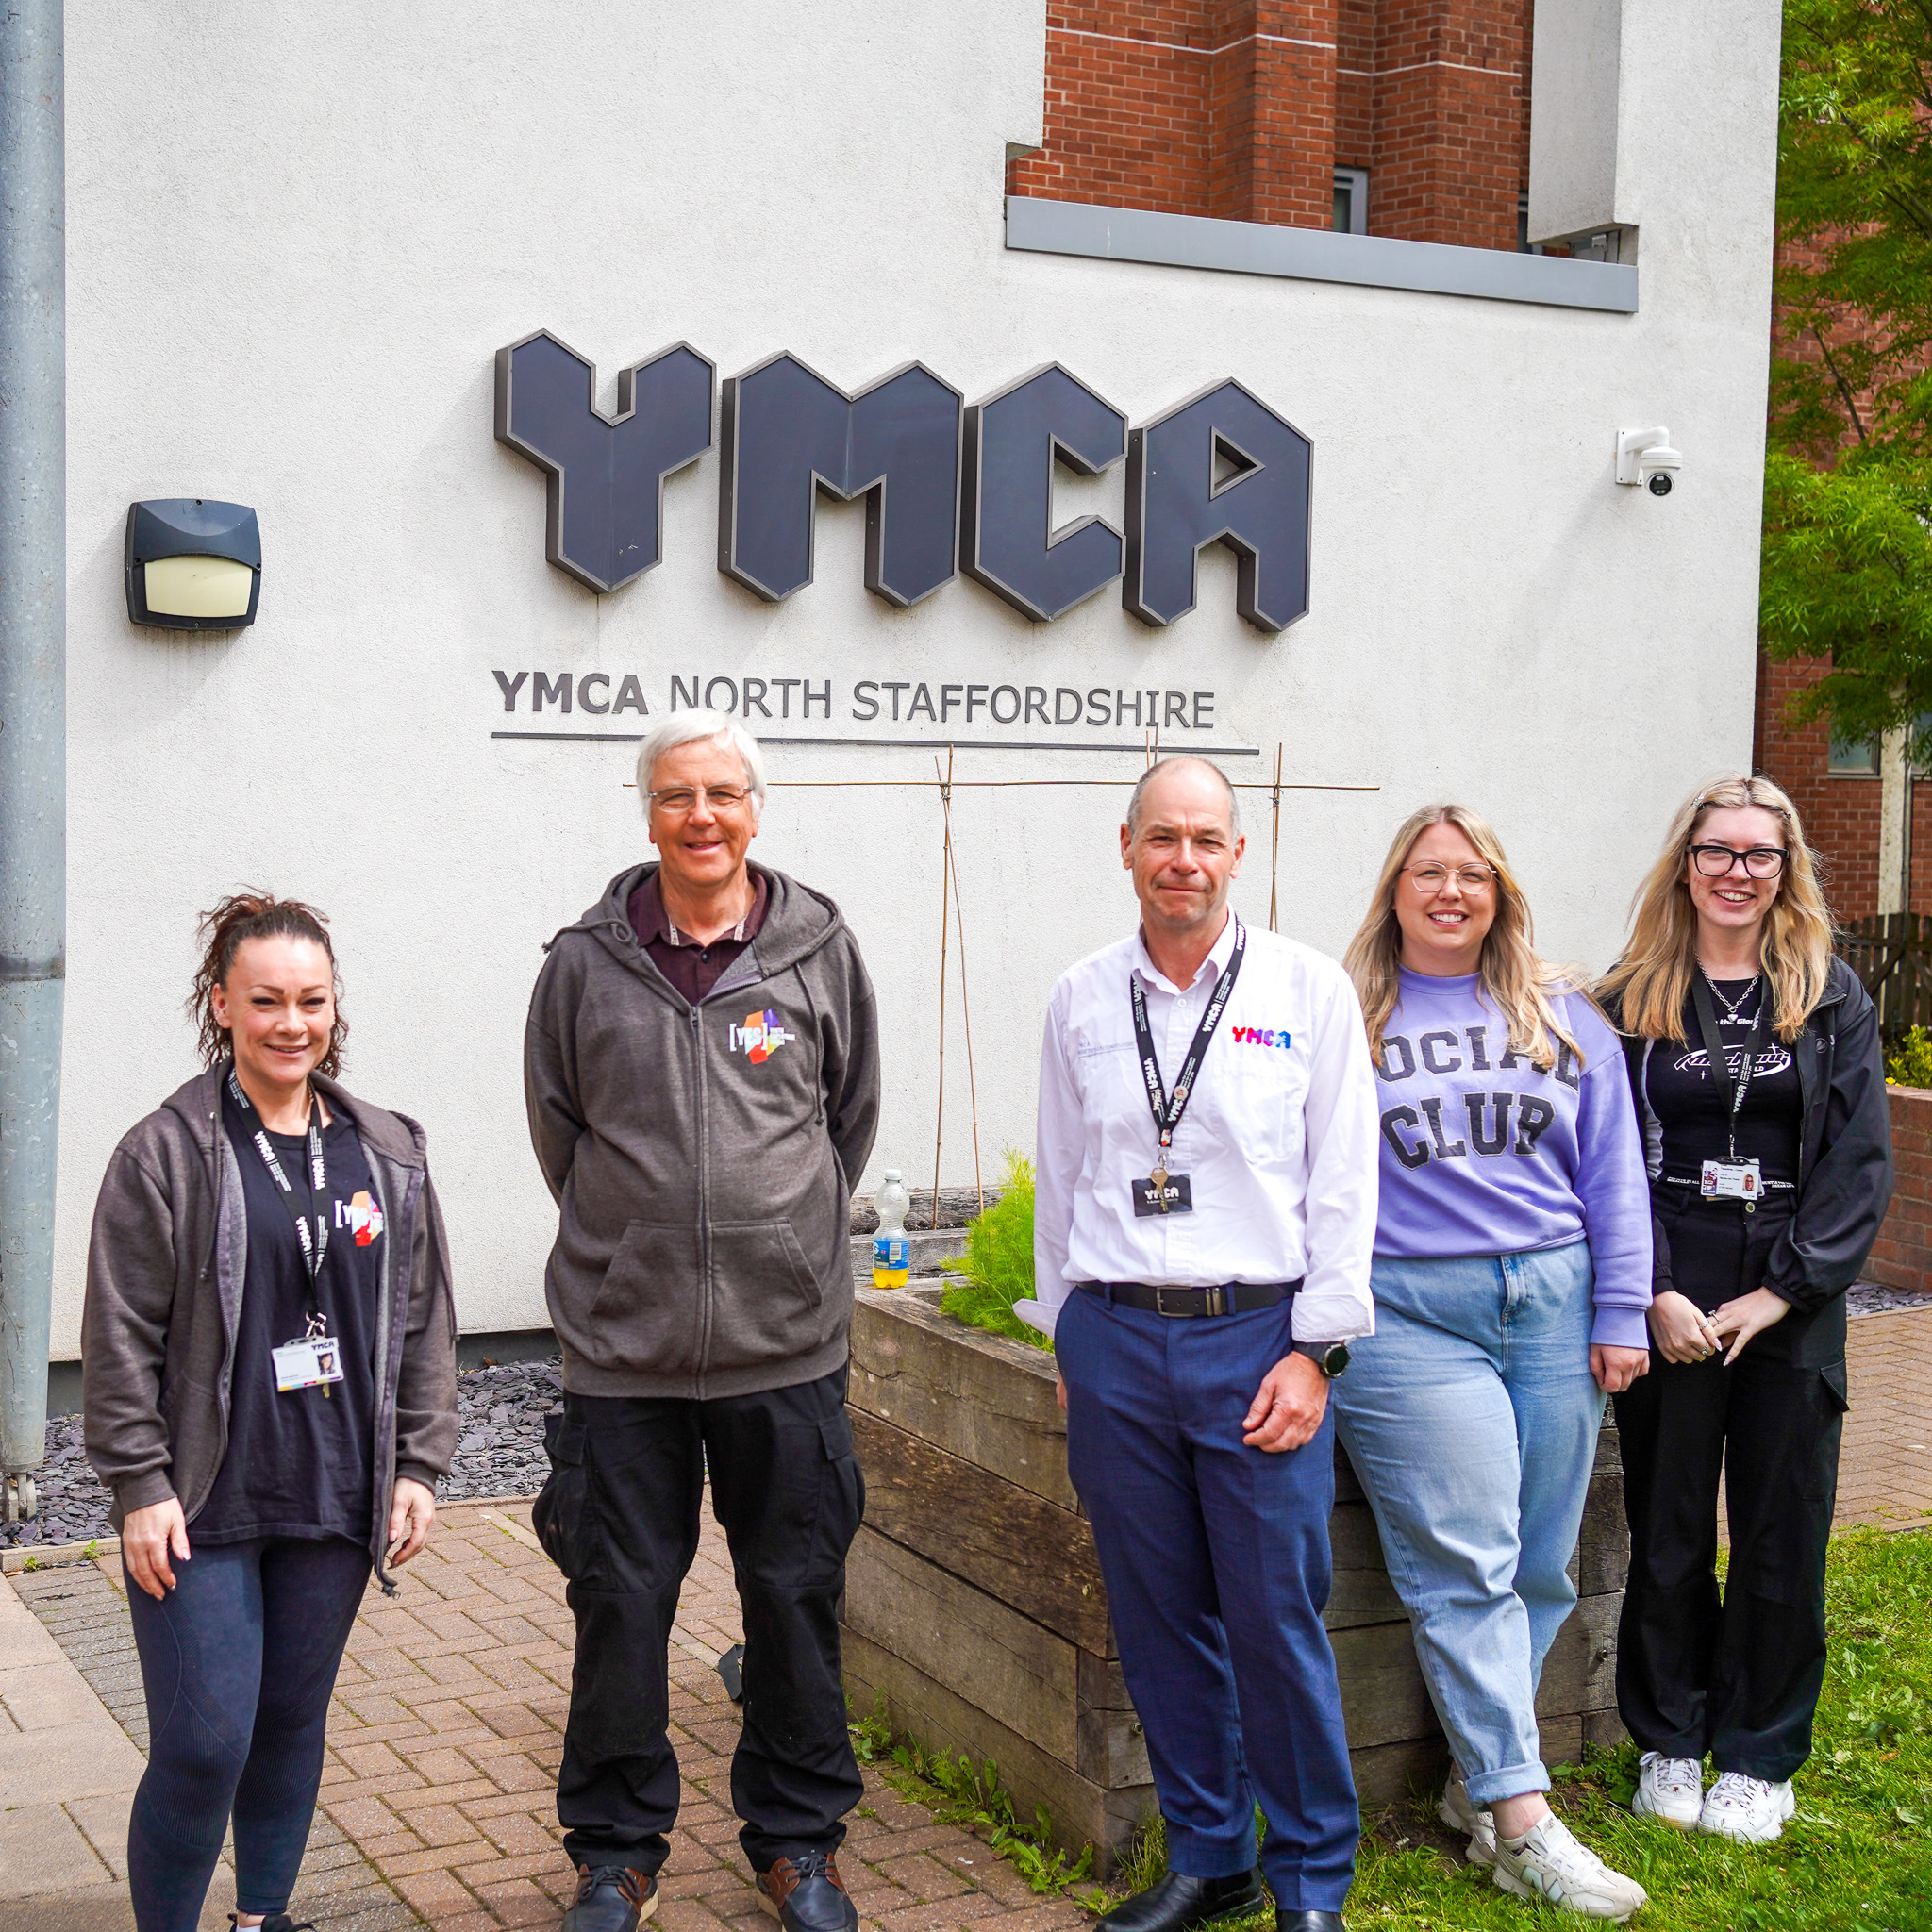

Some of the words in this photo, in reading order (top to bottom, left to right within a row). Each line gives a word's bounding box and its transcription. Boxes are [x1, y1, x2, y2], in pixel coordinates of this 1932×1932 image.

[494, 327, 1314, 633] YMCA
[491, 670, 648, 715] YMCA
[668, 675, 832, 719] NORTH
[852, 680, 1216, 729] STAFFORDSHIRE
[1202, 1003, 1223, 1032] YMCA
[1232, 1026, 1291, 1049] YMCA
[1143, 1057, 1158, 1090] YMCA
[1167, 1099, 1184, 1122] YMC
[1733, 1085, 1747, 1113] YMCA
[254, 1130, 275, 1162] YMCA
[295, 1216, 313, 1251] YMCA
[311, 1341, 334, 1351] YMCA
